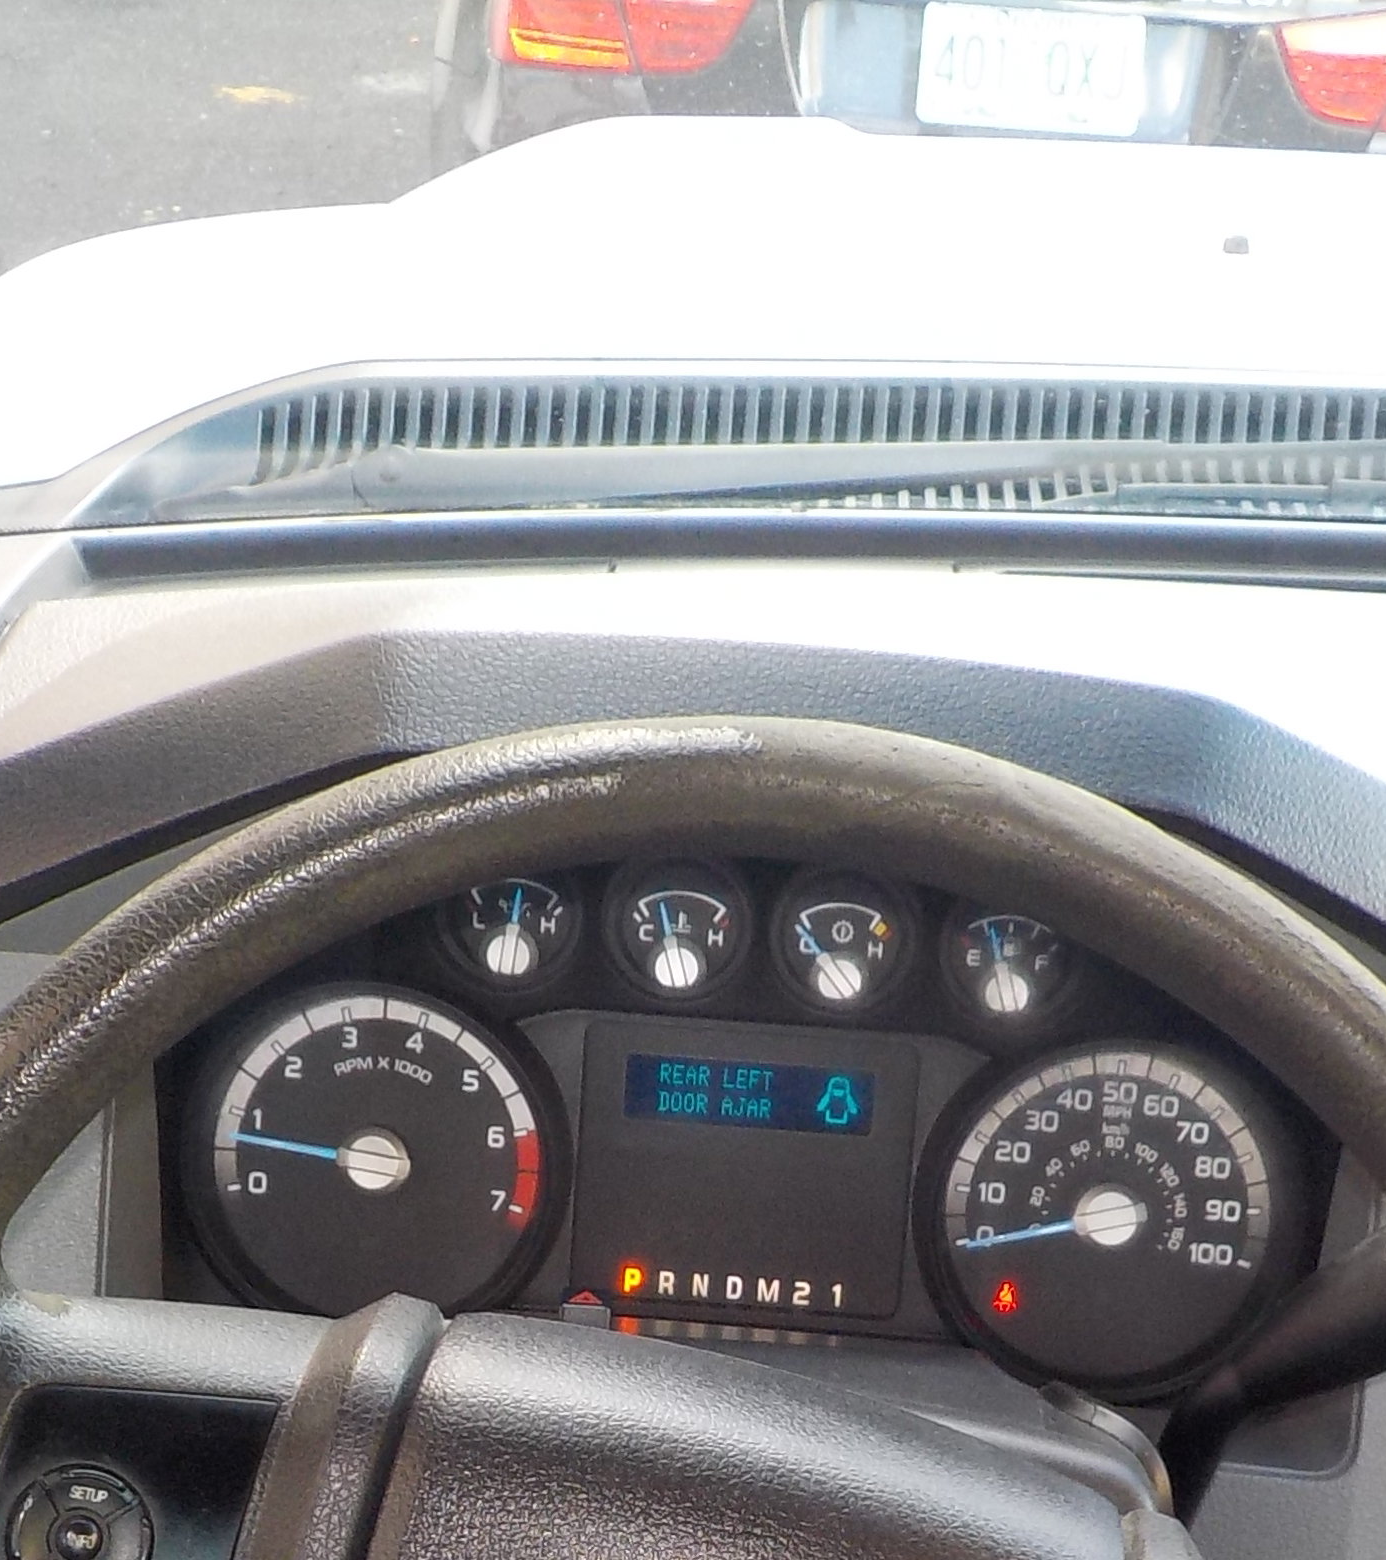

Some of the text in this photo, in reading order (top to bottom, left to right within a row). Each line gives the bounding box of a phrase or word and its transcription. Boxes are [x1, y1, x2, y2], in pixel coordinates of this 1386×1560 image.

[540, 917, 556, 935] H
[638, 923, 724, 947] C H
[867, 941, 883, 960] H
[966, 949, 1050, 971] E F
[341, 1026, 358, 1048] 3
[405, 1031, 425, 1054] 4
[284, 1056, 303, 1079] 2
[333, 1057, 374, 1078] RPM
[394, 1058, 433, 1086] 1000
[659, 1063, 774, 1091] REAR LEFT
[462, 1069, 480, 1092] 5
[1056, 1089, 1093, 1112] 40
[1102, 1081, 1138, 1104] 50
[658, 1091, 771, 1119] DOOR AJAR
[1143, 1095, 1180, 1118] 60
[252, 1107, 263, 1131] 1
[1024, 1110, 1059, 1133] 30
[487, 1126, 505, 1149] 6
[1105, 1135, 1125, 1150] 80
[1175, 1121, 1210, 1144] 70
[994, 1141, 1031, 1164] 20
[1069, 1139, 1091, 1158] 60
[1134, 1142, 1159, 1163] 100
[1045, 1157, 1063, 1177] 40
[1160, 1162, 1180, 1188] 120
[1194, 1155, 1231, 1179] 80
[248, 1171, 268, 1194] 0
[978, 1182, 1006, 1204] 10
[490, 1190, 506, 1212] 7
[1029, 1186, 1045, 1208] 20
[1205, 1199, 1242, 1223] 90
[1189, 1242, 1233, 1266] 100
[623, 1267, 845, 1308] P R N D M 2 1
[69, 1485, 109, 1503] SETUP
[66, 1531, 98, 1549] INFO
